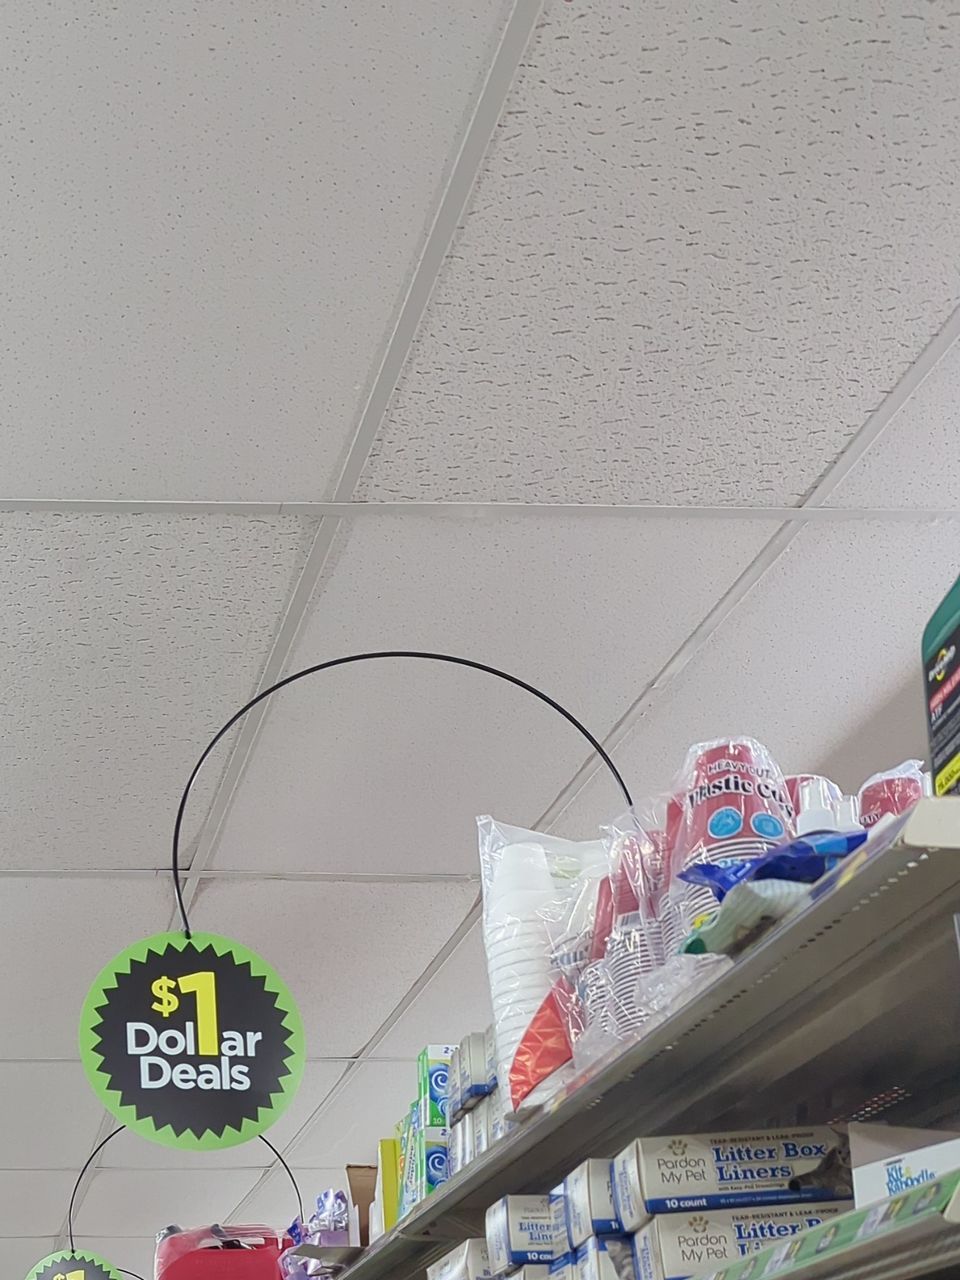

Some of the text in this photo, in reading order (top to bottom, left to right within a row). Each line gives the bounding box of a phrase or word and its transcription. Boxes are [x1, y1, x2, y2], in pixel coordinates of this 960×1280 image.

[708, 760, 773, 779] HEAVY DUT
[151, 971, 219, 1056] $1
[126, 1021, 263, 1057] Dollar
[140, 1056, 252, 1091] Deals
[713, 1142, 826, 1164] Litter Box
[657, 1156, 707, 1171] Pardon
[661, 1169, 707, 1185] My Pet
[717, 1164, 792, 1183] Liners
[665, 1198, 707, 1209] 10 count
[677, 1234, 728, 1248] Pardon
[734, 1223, 803, 1241] Litter
[527, 1252, 539, 1261] 10
[681, 1247, 729, 1263] My Pet
